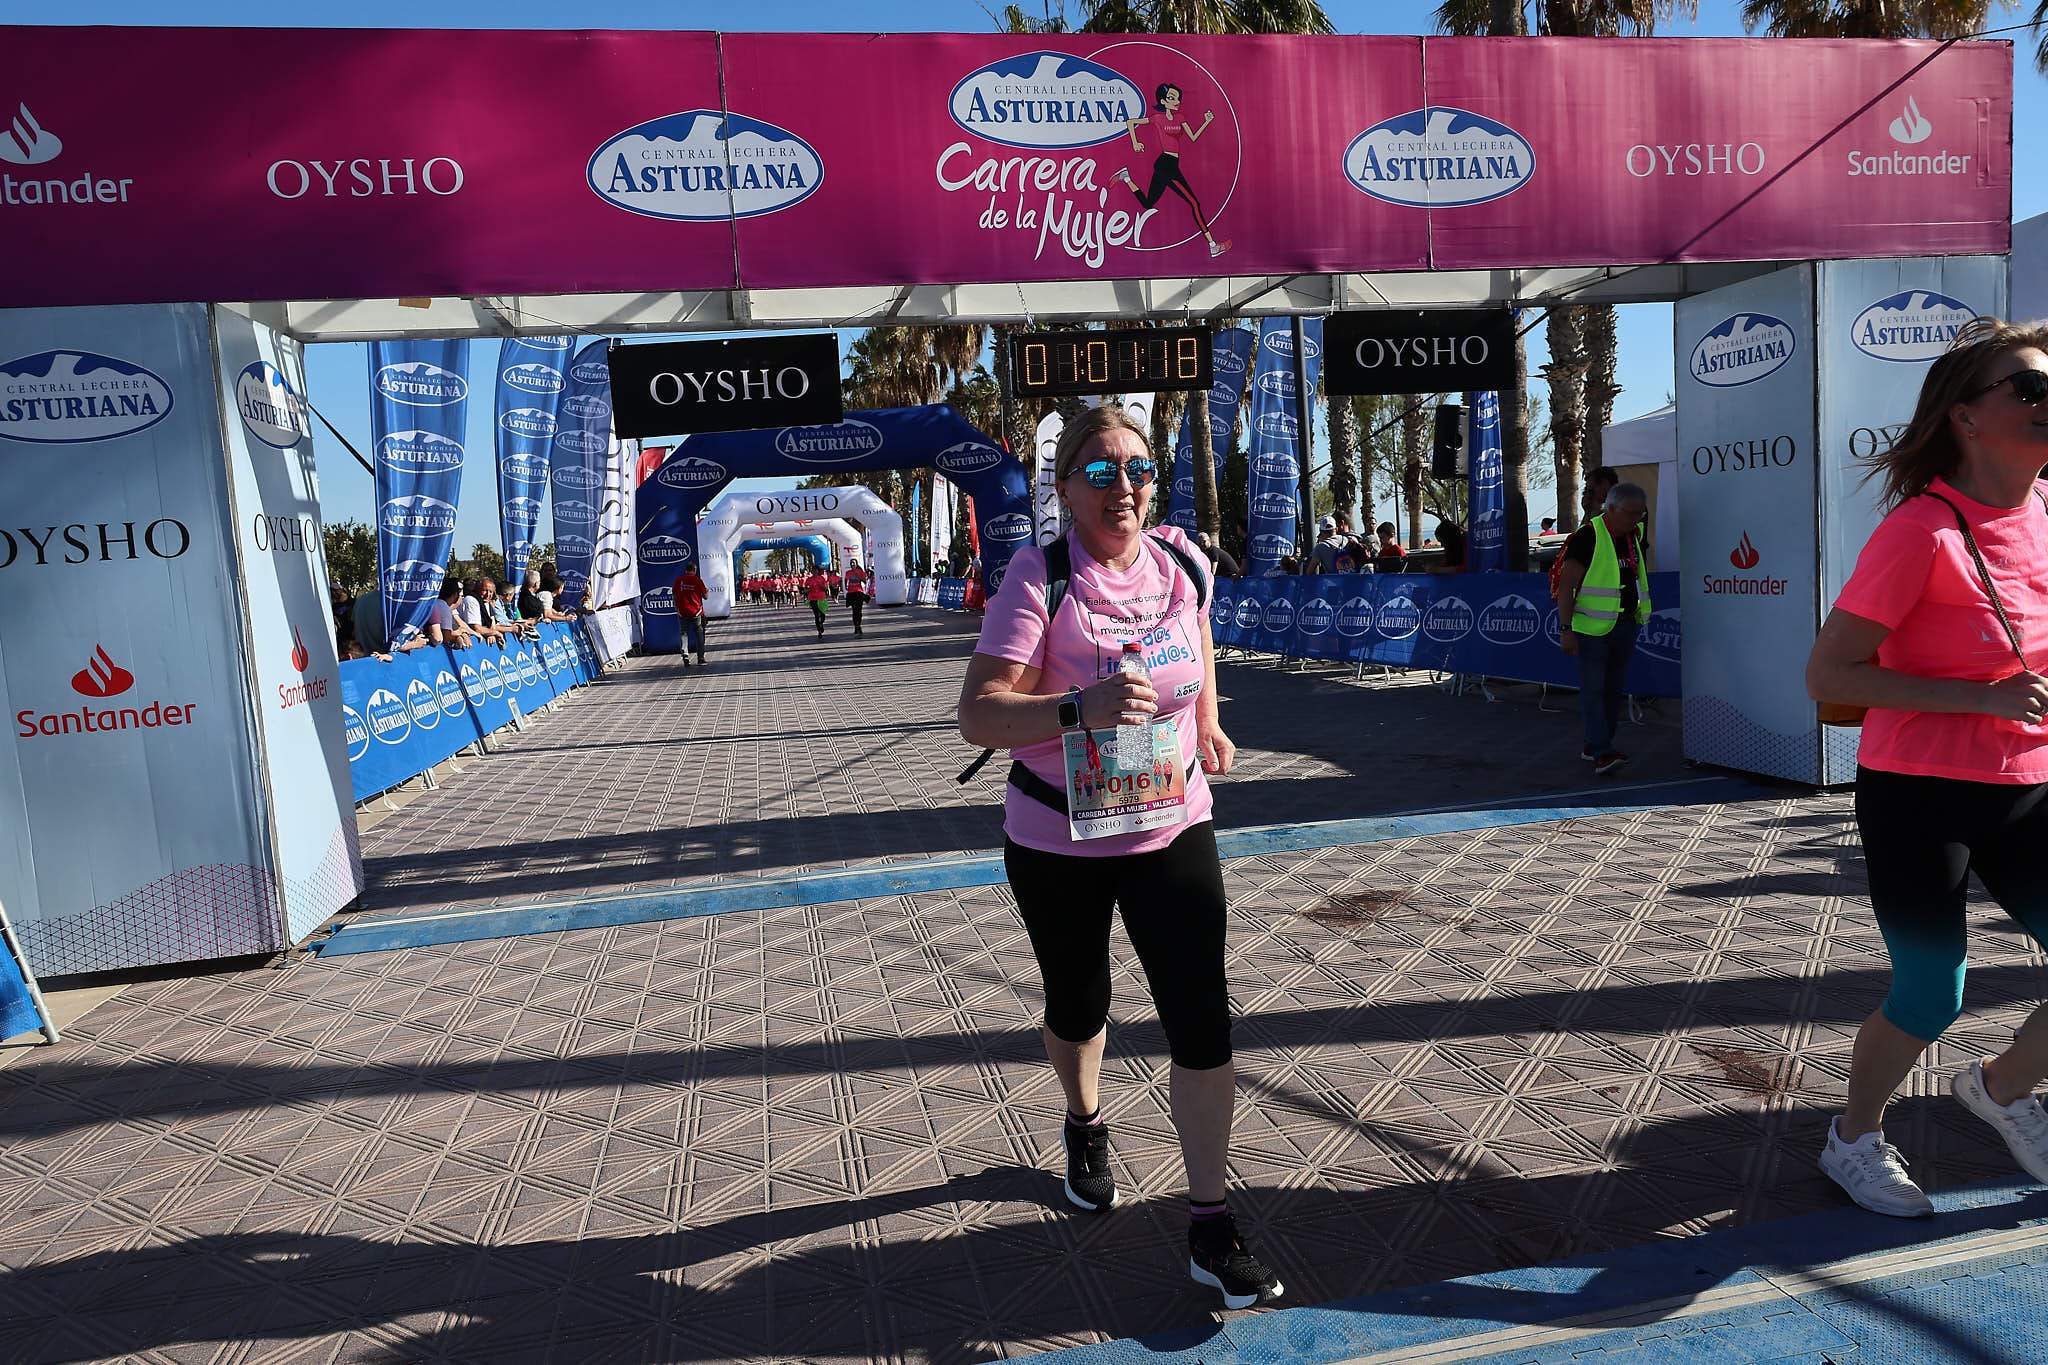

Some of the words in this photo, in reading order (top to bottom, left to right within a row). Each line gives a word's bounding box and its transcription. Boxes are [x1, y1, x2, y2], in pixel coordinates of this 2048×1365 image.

[994, 85, 1057, 95] CENTRAL
[1062, 85, 1124, 95] LECHERA
[965, 87, 1130, 124] ASTURIANA
[641, 149, 716, 160] CENTRAL
[1387, 142, 1447, 152] CENTRAL
[1454, 141, 1514, 150] LECHERA
[936, 142, 1098, 192] Carrera
[1359, 145, 1521, 181] ASTURIANA
[1625, 142, 1766, 178] OYSHO
[1848, 149, 1971, 177] Santander
[266, 156, 465, 199] OYSHO
[607, 152, 807, 193] ASTURIANA
[0, 172, 133, 205] tander
[979, 194, 1009, 229] de
[1016, 193, 1037, 229] la
[1034, 187, 1158, 268] Mujer
[1880, 314, 1921, 323] CENTRAL
[1924, 312, 1966, 322] LECHERA
[1711, 339, 1744, 352] CENTRAL
[1746, 330, 1784, 345] LECHERA
[1860, 319, 1962, 346] ASTURIAN
[1355, 335, 1489, 368] OYSHO
[1696, 338, 1787, 376] ASTURIANA
[7, 383, 76, 393] CENTRAL
[81, 380, 149, 391] LECHERA
[380, 373, 461, 397] ASTURIANA
[650, 367, 810, 406] OYSHO
[0, 392, 160, 423] STURIANA
[382, 442, 460, 464] ASTURIANA
[784, 433, 876, 452] ASTURIANA
[941, 453, 998, 467] ASTURIANA
[1693, 435, 1796, 476] OYSHO
[662, 470, 721, 481] ASTURIANA
[756, 493, 839, 515] OYSHO
[382, 509, 454, 528] ASTURIANA
[254, 513, 317, 554] OYSHO
[640, 547, 688, 558] ASTURIANA
[1703, 574, 1788, 595] Santander
[1109, 611, 1153, 624] Construir
[1378, 611, 1416, 629] ASTURIANA
[1426, 613, 1469, 631] ASTURIANA
[1481, 613, 1535, 634] ASTURIANA
[1100, 626, 1135, 636] mundo
[278, 676, 329, 710] Santander
[17, 701, 196, 738] Santander
[1077, 810, 1106, 819] CARRERA
[1117, 806, 1125, 814] LA
[1126, 804, 1148, 813] MUJER
[1152, 798, 1179, 808] VALENCIA
[1119, 796, 1139, 805] 5979
[1085, 820, 1121, 833] OYSHO
[1144, 812, 1175, 824] Santander
